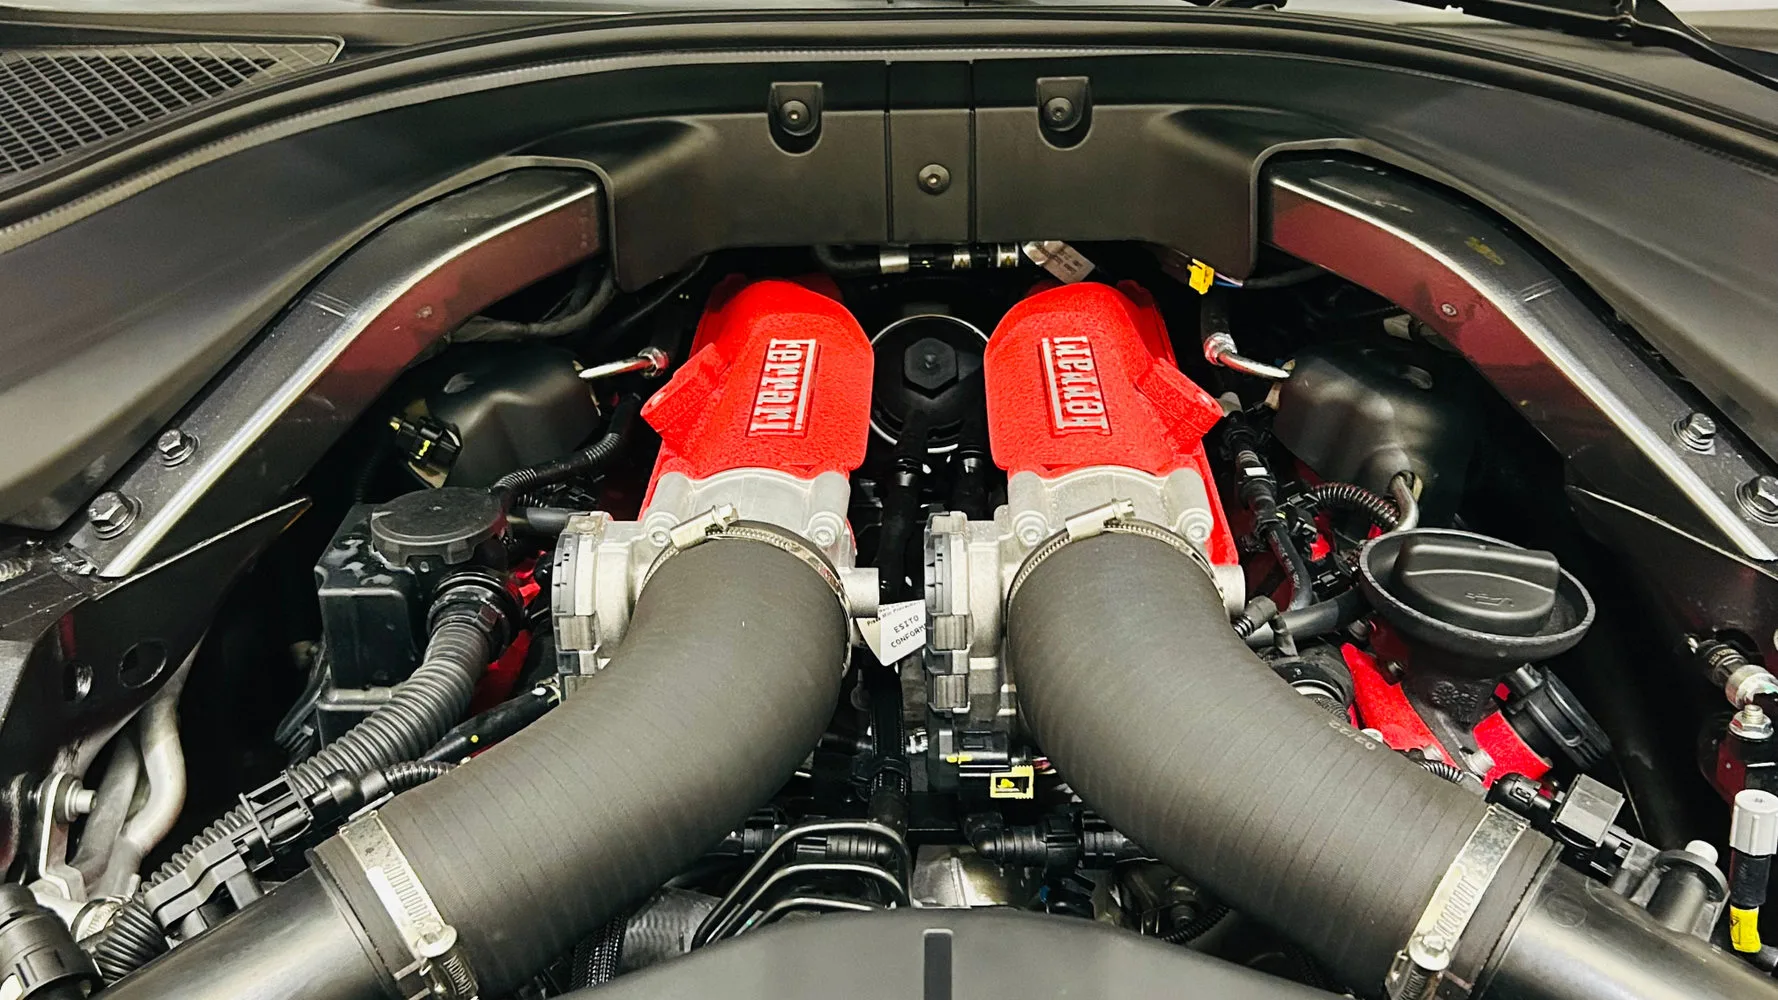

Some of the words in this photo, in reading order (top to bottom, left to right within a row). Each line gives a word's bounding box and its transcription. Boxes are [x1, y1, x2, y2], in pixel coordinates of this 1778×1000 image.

[749, 338, 817, 433] Ferrari
[1041, 335, 1109, 430] Ferrari
[893, 614, 920, 634] ESITO
[443, 954, 473, 996] NORMA
